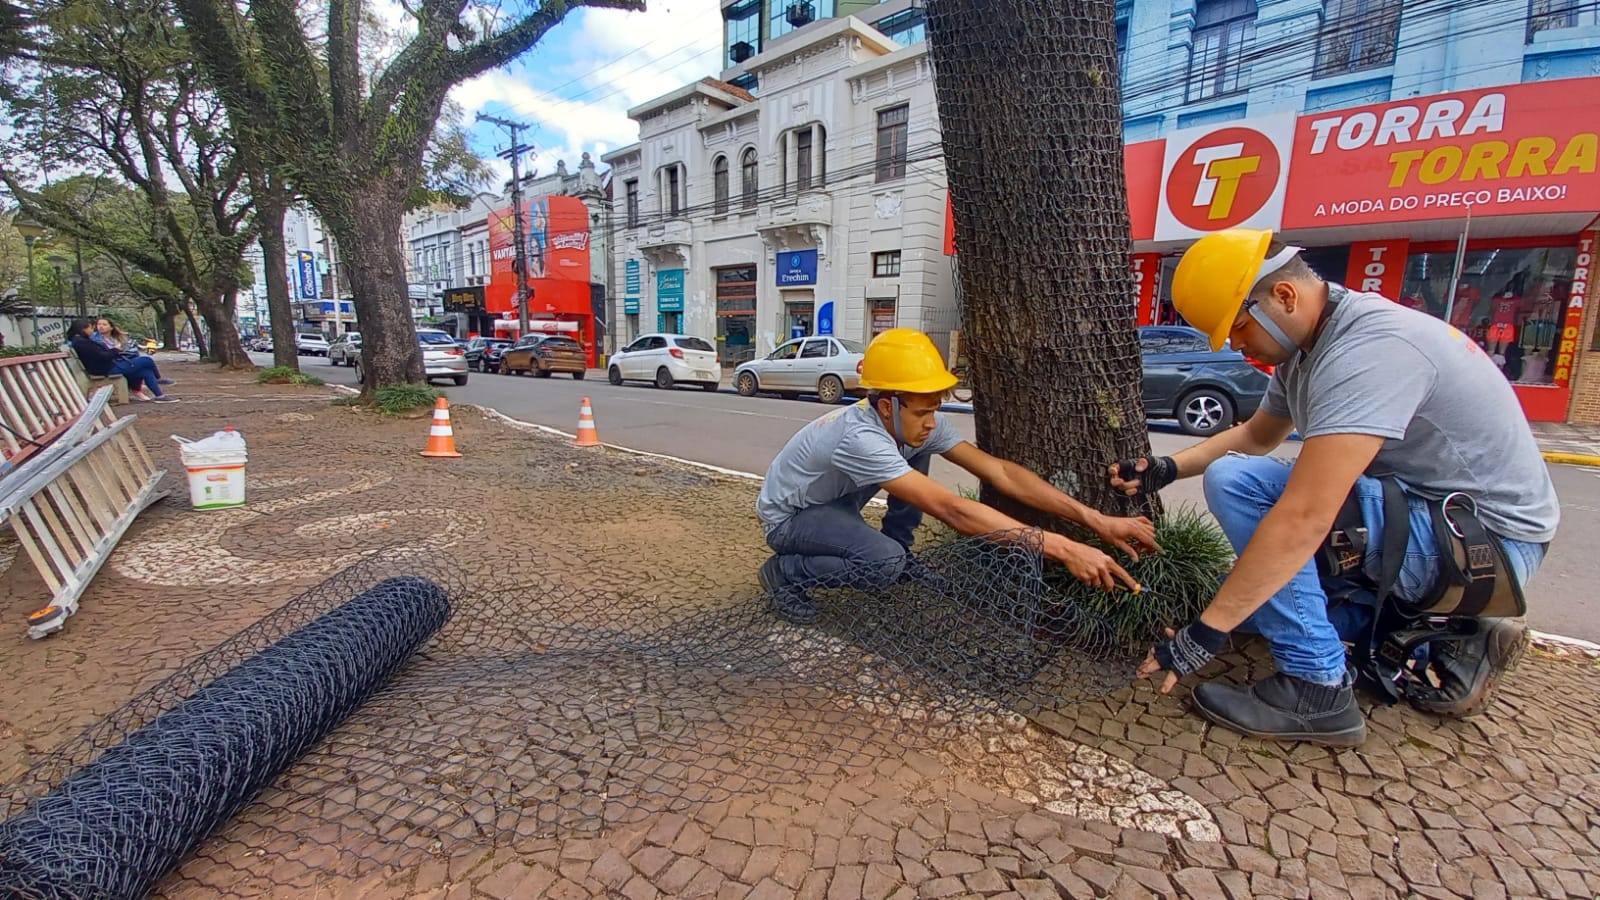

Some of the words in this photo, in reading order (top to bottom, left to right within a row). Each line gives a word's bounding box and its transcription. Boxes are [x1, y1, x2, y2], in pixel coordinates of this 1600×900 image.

[1310, 93, 1506, 154] TORRA
[1388, 133, 1598, 188] TORRA
[1314, 204, 1326, 217] A
[1330, 199, 1385, 215] MODA
[1389, 196, 1419, 211] DO
[1423, 190, 1491, 209] PREÇO
[1496, 185, 1567, 203] BAIXO!
[304, 262, 314, 296] Colombo
[782, 273, 810, 282] Erechim
[1568, 239, 1592, 308] TORRA
